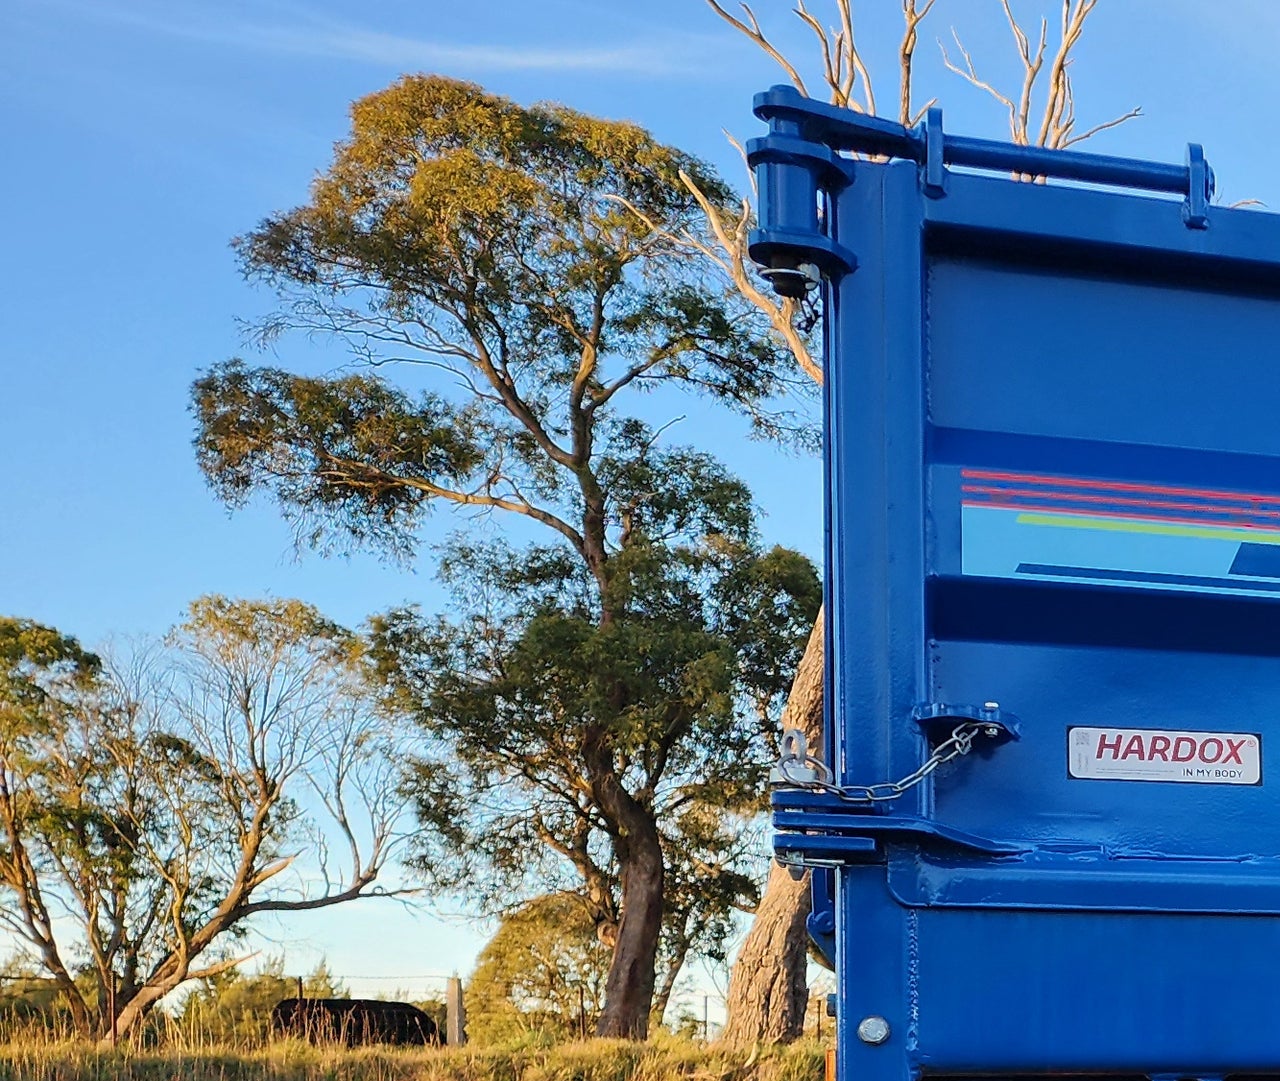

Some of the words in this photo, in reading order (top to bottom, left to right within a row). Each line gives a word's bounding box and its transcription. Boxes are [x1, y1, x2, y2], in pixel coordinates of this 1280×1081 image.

[1096, 733, 1247, 765] HARDOX
[1182, 768, 1193, 777] IN
[1196, 769, 1213, 778] MY
[1215, 769, 1243, 779] BODY
